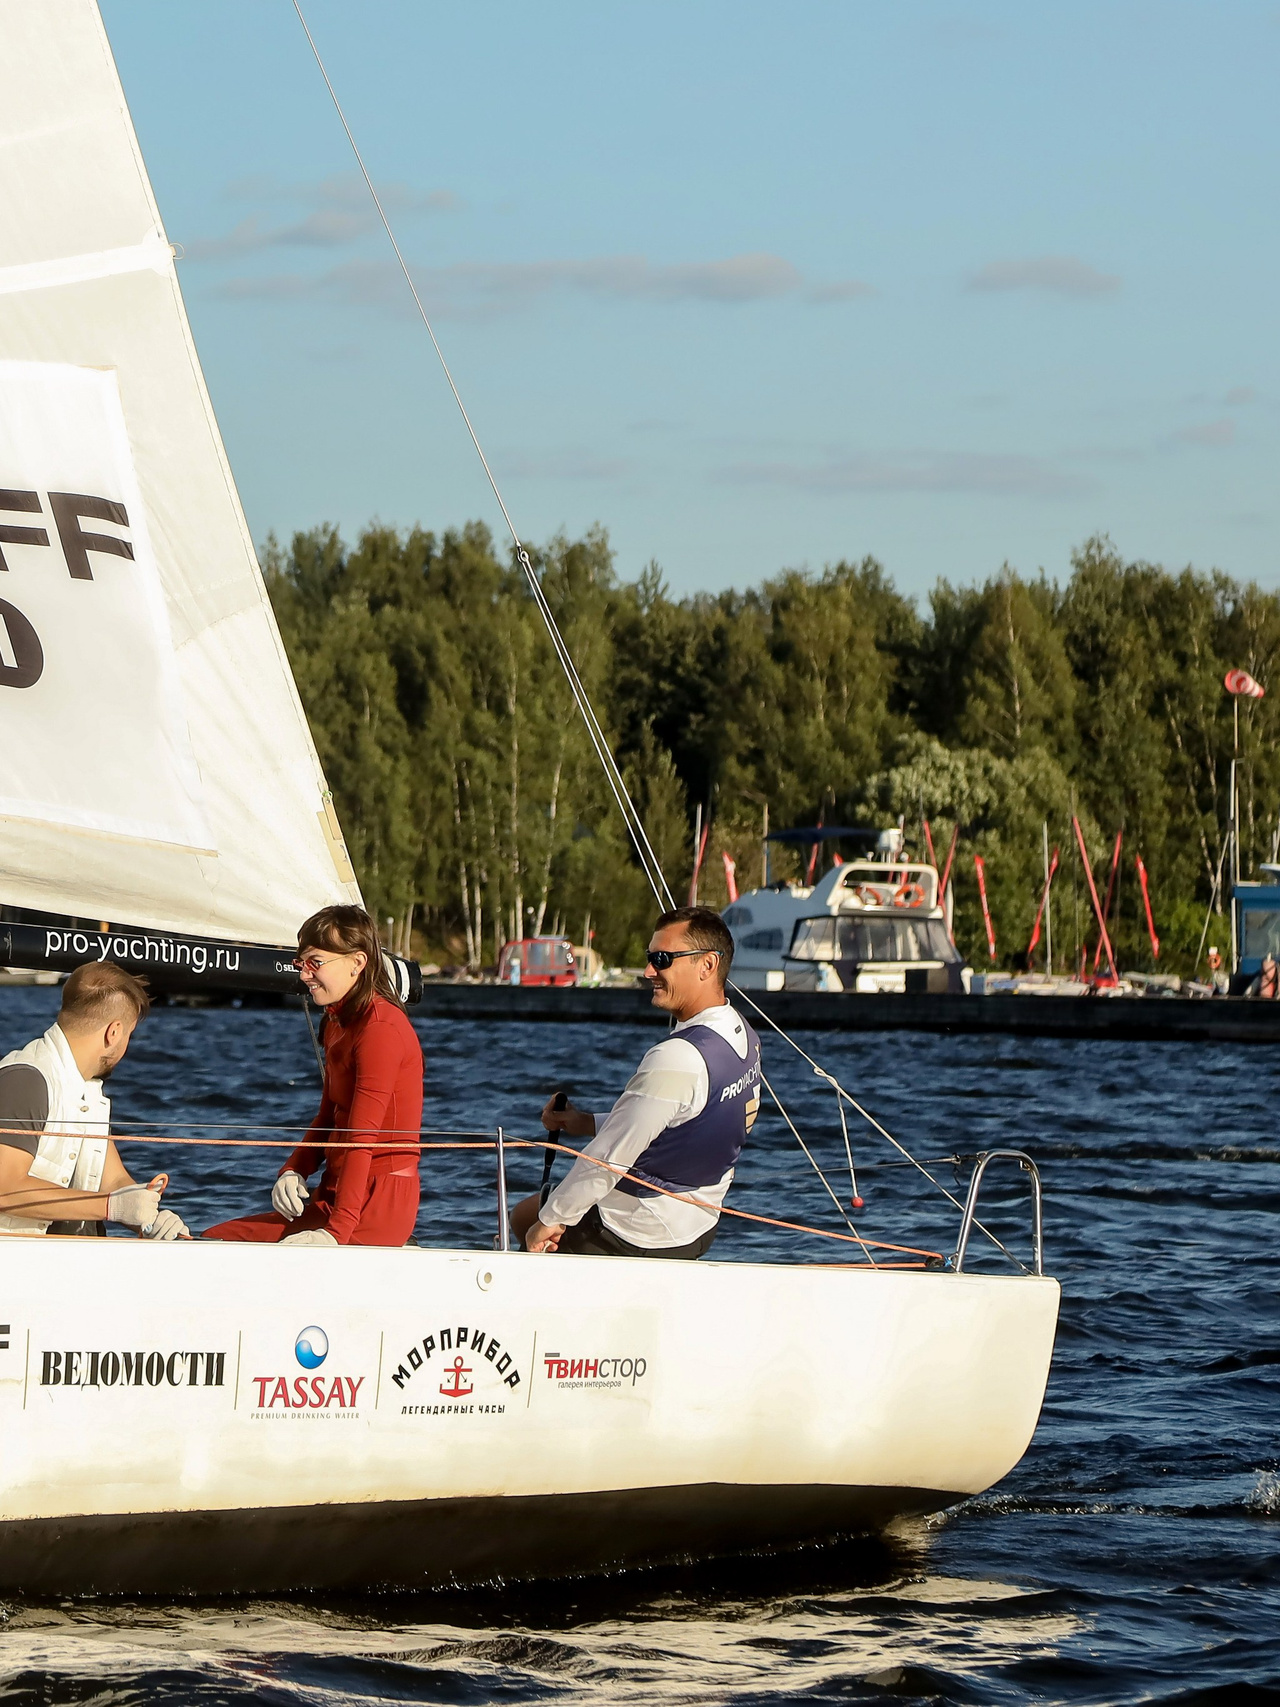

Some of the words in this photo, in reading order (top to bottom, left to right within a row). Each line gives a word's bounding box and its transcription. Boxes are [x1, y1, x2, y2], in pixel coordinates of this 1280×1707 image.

[45, 930, 240, 973] pro-yachting.ru
[40, 1351, 227, 1391] ВЕДОМОСТИ
[391, 1327, 521, 1390] МОРПРИБОР
[252, 1376, 366, 1408] TASSAY
[558, 1381, 583, 1390] галерея
[584, 1380, 622, 1390] интерьеров
[250, 1412, 288, 1420] PREMIUM
[401, 1405, 475, 1415] ЛЕГЕНДАРНЫЕ
[478, 1404, 506, 1414] ЧАСЫ
